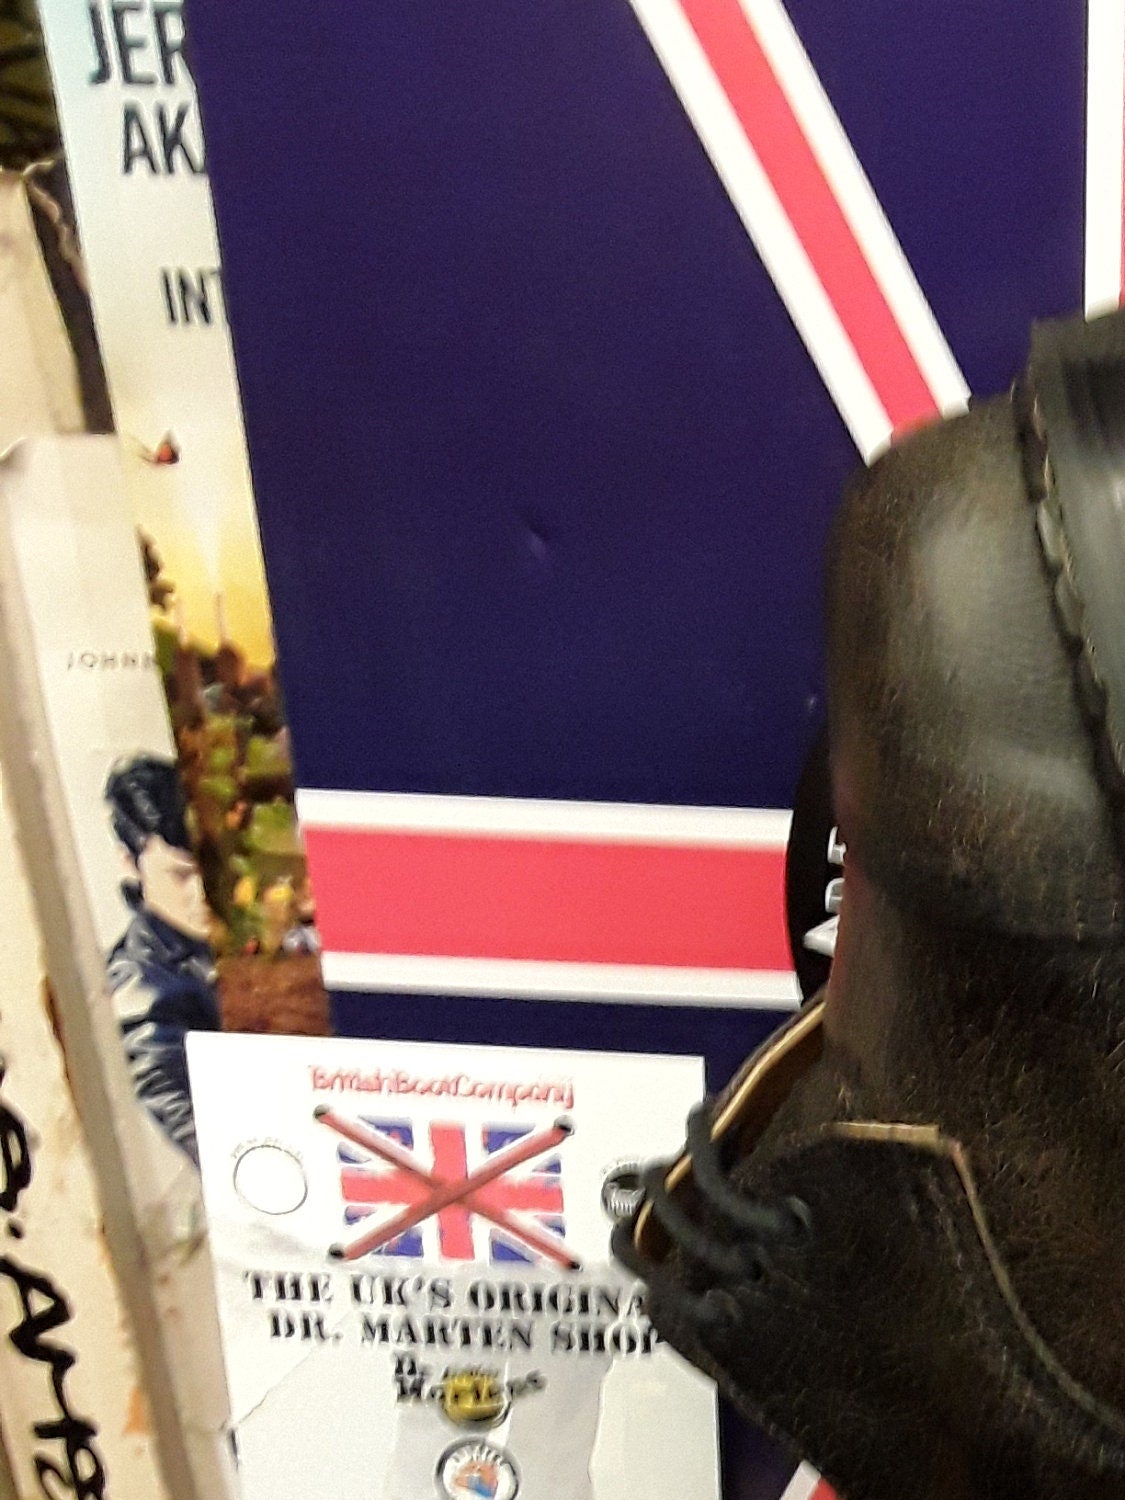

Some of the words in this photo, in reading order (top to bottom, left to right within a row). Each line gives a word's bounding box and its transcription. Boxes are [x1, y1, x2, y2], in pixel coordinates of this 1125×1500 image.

[243, 1269, 334, 1302] THE
[350, 1273, 452, 1309] UK'S
[468, 1281, 648, 1318] ORIGINA
[270, 1307, 343, 1342] DR.
[361, 1311, 534, 1350] MARTEN
